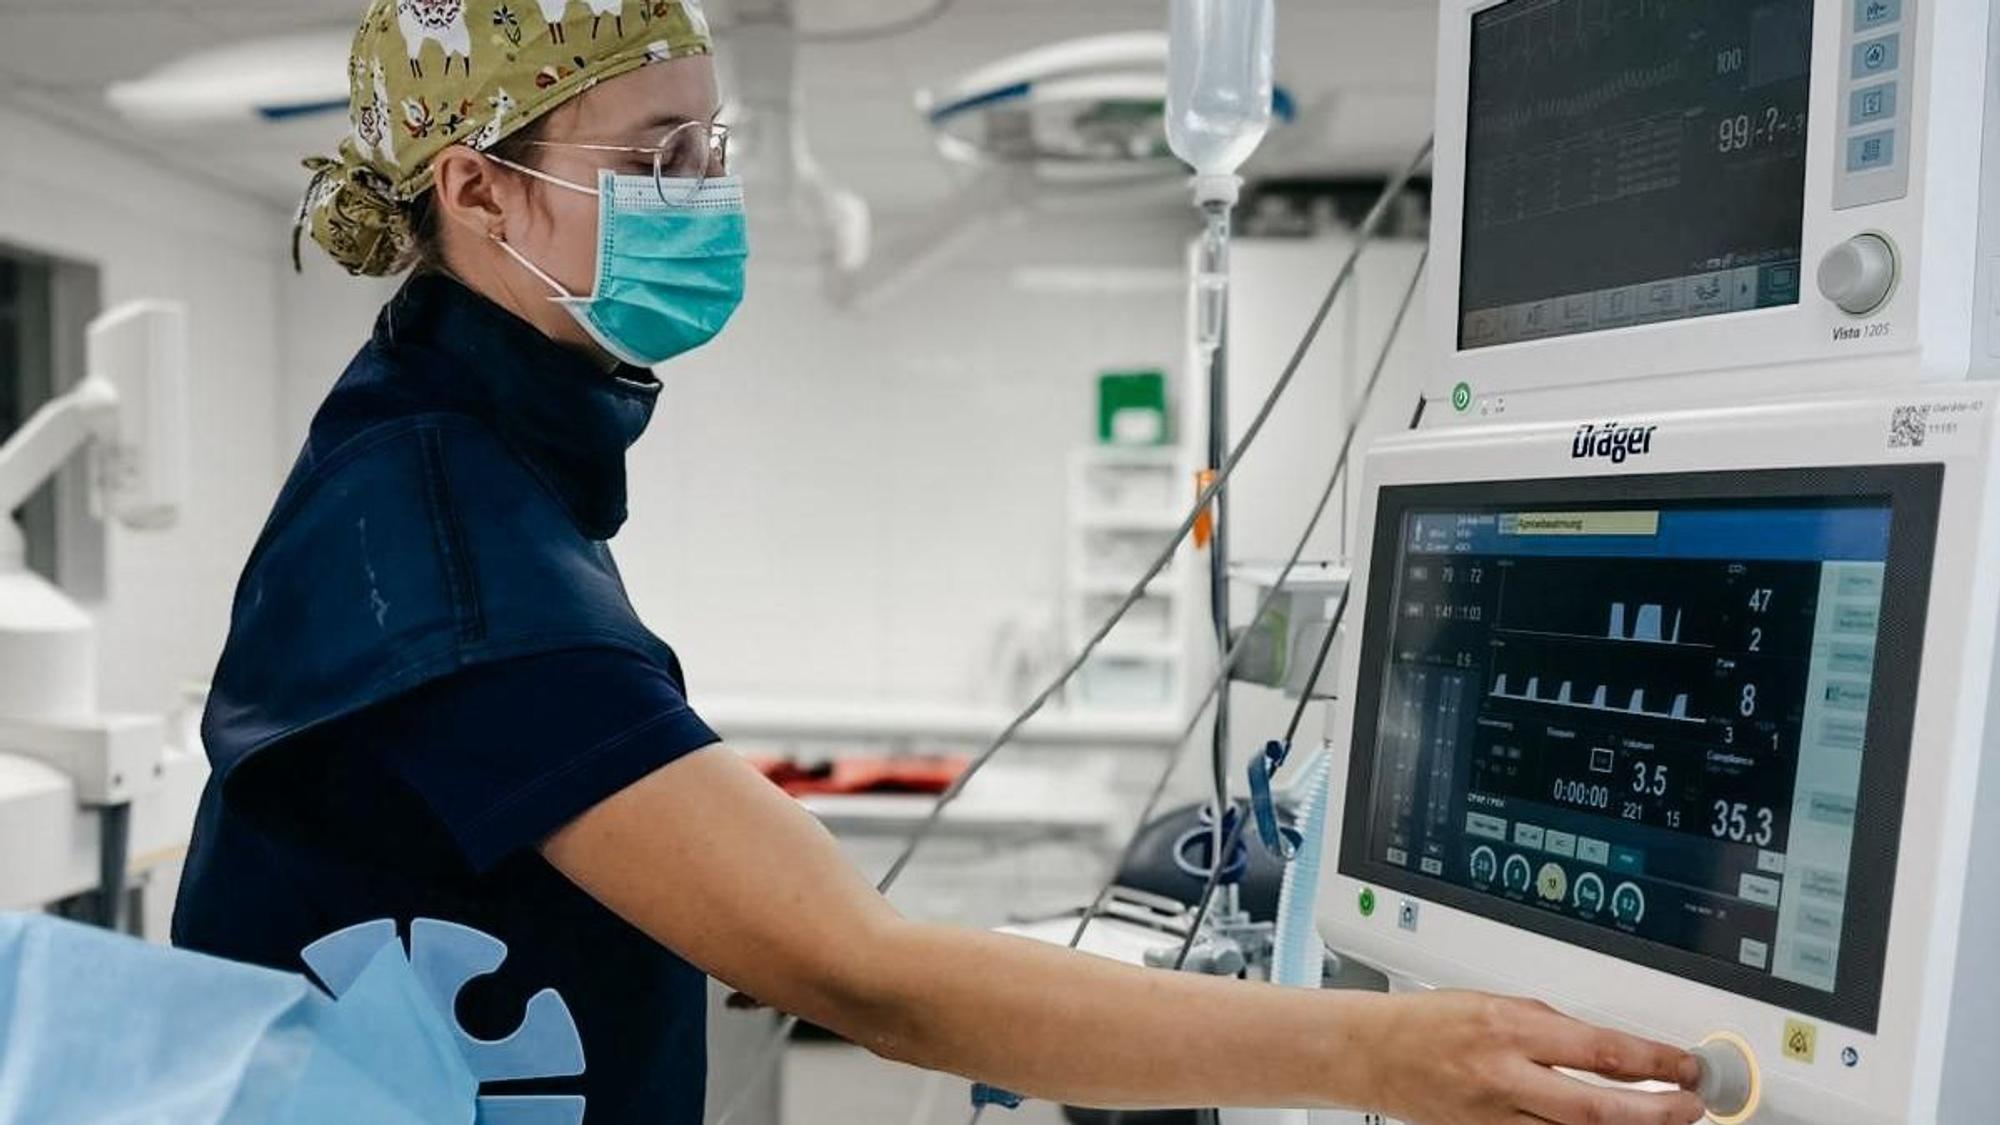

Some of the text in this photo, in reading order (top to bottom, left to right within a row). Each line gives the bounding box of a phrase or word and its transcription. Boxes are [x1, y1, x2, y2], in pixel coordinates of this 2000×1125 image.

[1718, 48, 1742, 74] 100
[1833, 326, 1861, 341] Vista
[1572, 422, 1657, 464] Dräger
[1749, 587, 1773, 613] 47
[1748, 626, 1762, 652] 2
[1740, 682, 1757, 717] 8
[1724, 726, 1735, 744] 3
[1771, 732, 1780, 751] 1
[1632, 760, 1669, 797] 3.5
[1553, 777, 1609, 809] 0:00:00
[1621, 800, 1681, 829] 221 15
[1710, 798, 1774, 848] 35.3
